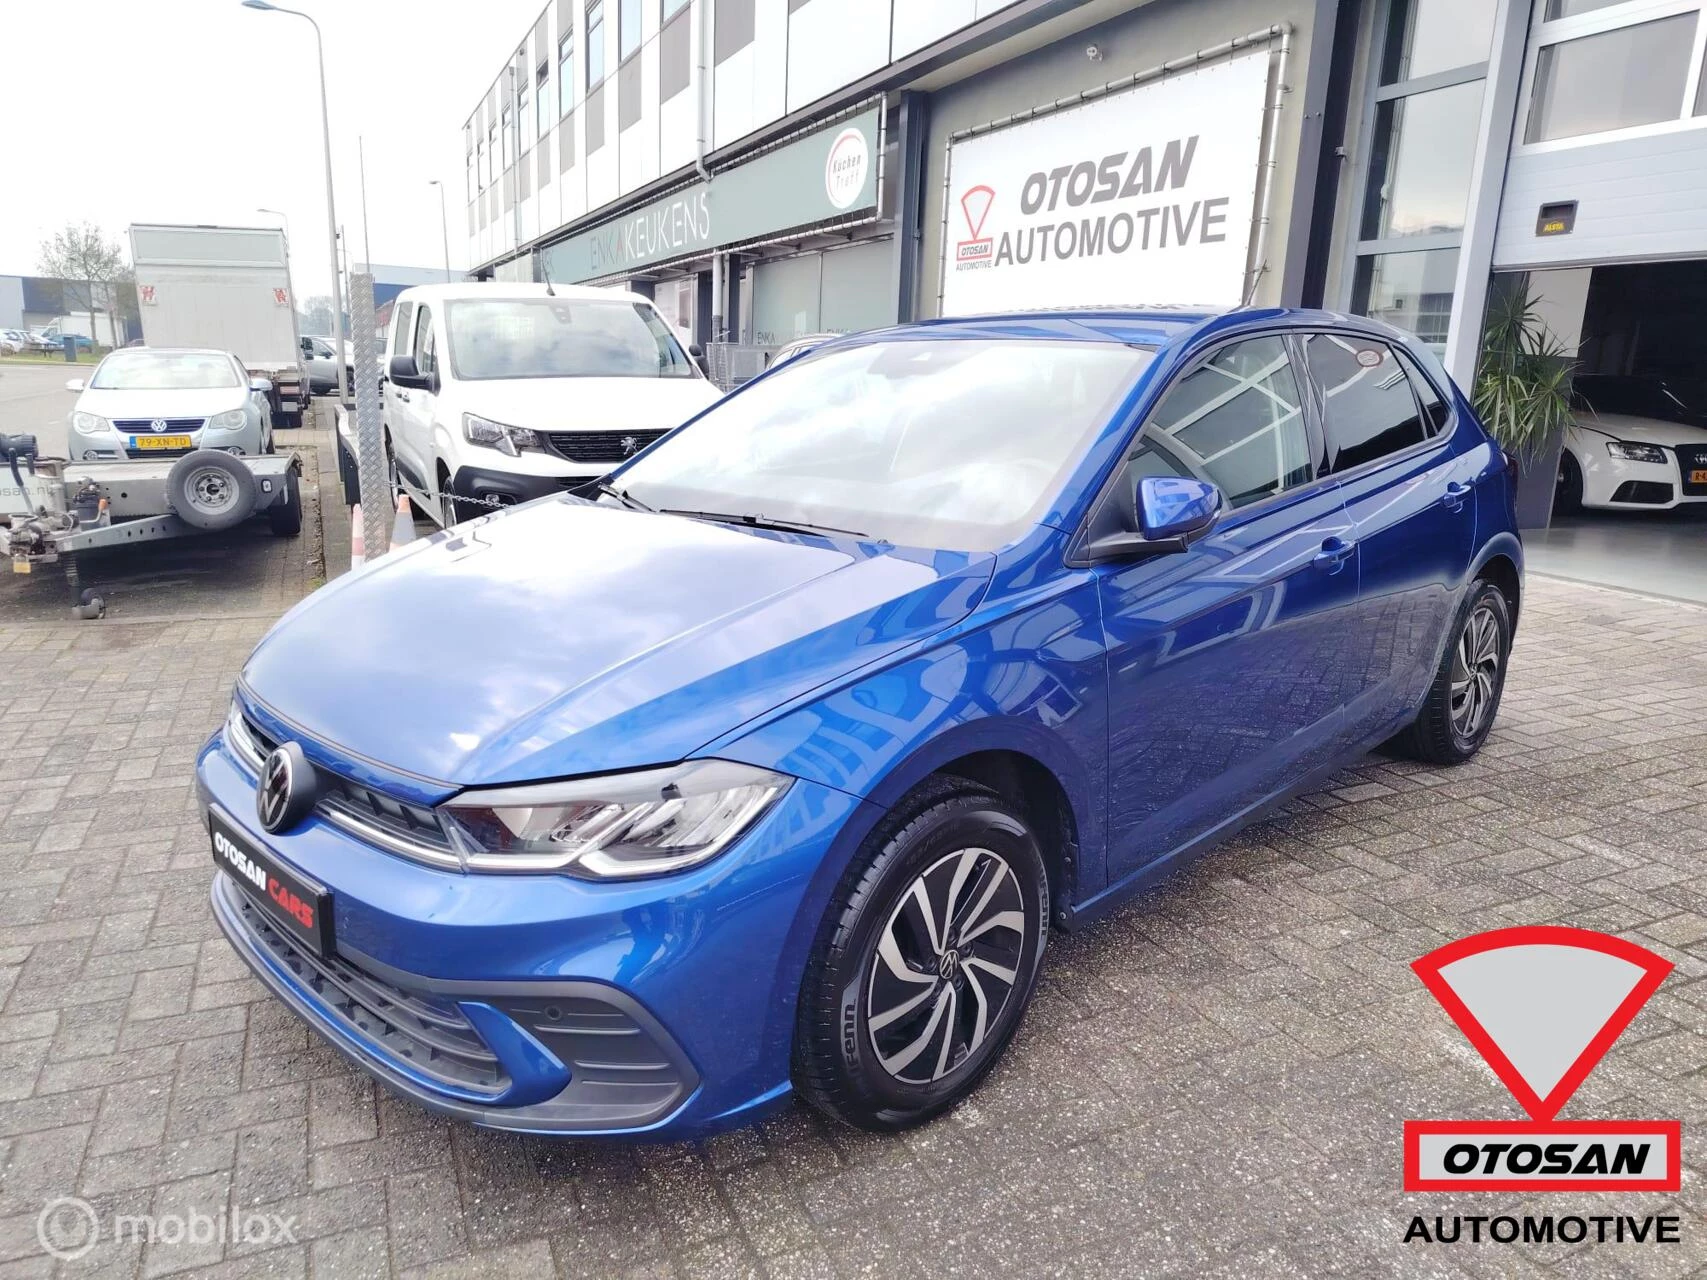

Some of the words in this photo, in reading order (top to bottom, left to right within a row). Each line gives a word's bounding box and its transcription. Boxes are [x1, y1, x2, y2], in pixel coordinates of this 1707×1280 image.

[1020, 134, 1200, 216] OTOSAN
[961, 244, 989, 256] OTOSAN
[994, 197, 1230, 267] AUTOMOTIVE
[956, 260, 992, 272] AUTOMOTIVE
[140, 437, 187, 447] 79-XN-TD
[214, 831, 267, 891] OTOSAN
[267, 874, 314, 929] CARS
